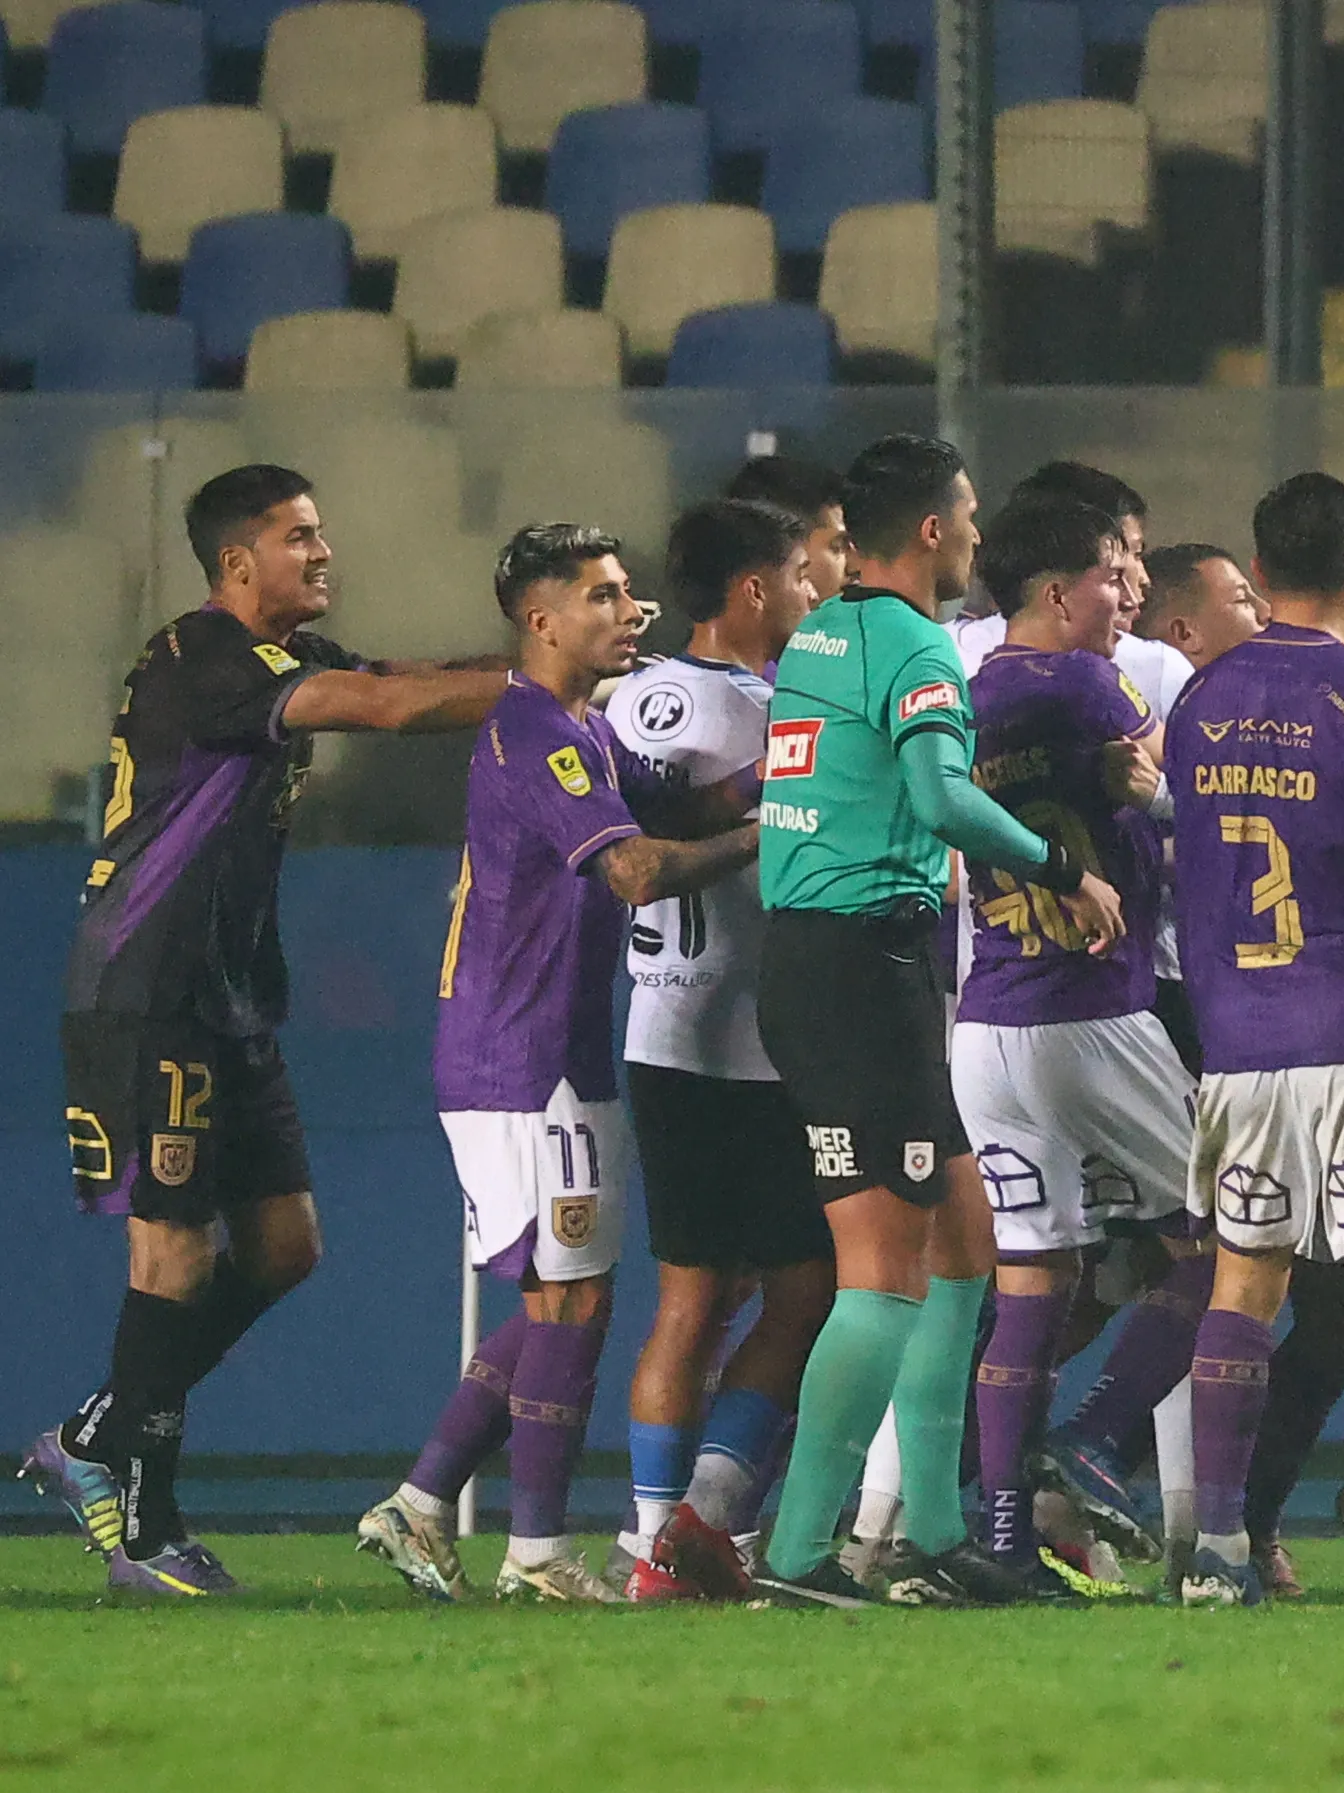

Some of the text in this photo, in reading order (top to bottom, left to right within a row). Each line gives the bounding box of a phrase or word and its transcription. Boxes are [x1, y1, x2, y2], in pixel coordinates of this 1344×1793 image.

[639, 692, 684, 730] PF
[1195, 765, 1316, 801] CARRASCO
[1219, 815, 1304, 969] 3
[159, 1060, 212, 1129] 12
[547, 1123, 600, 1188] 11
